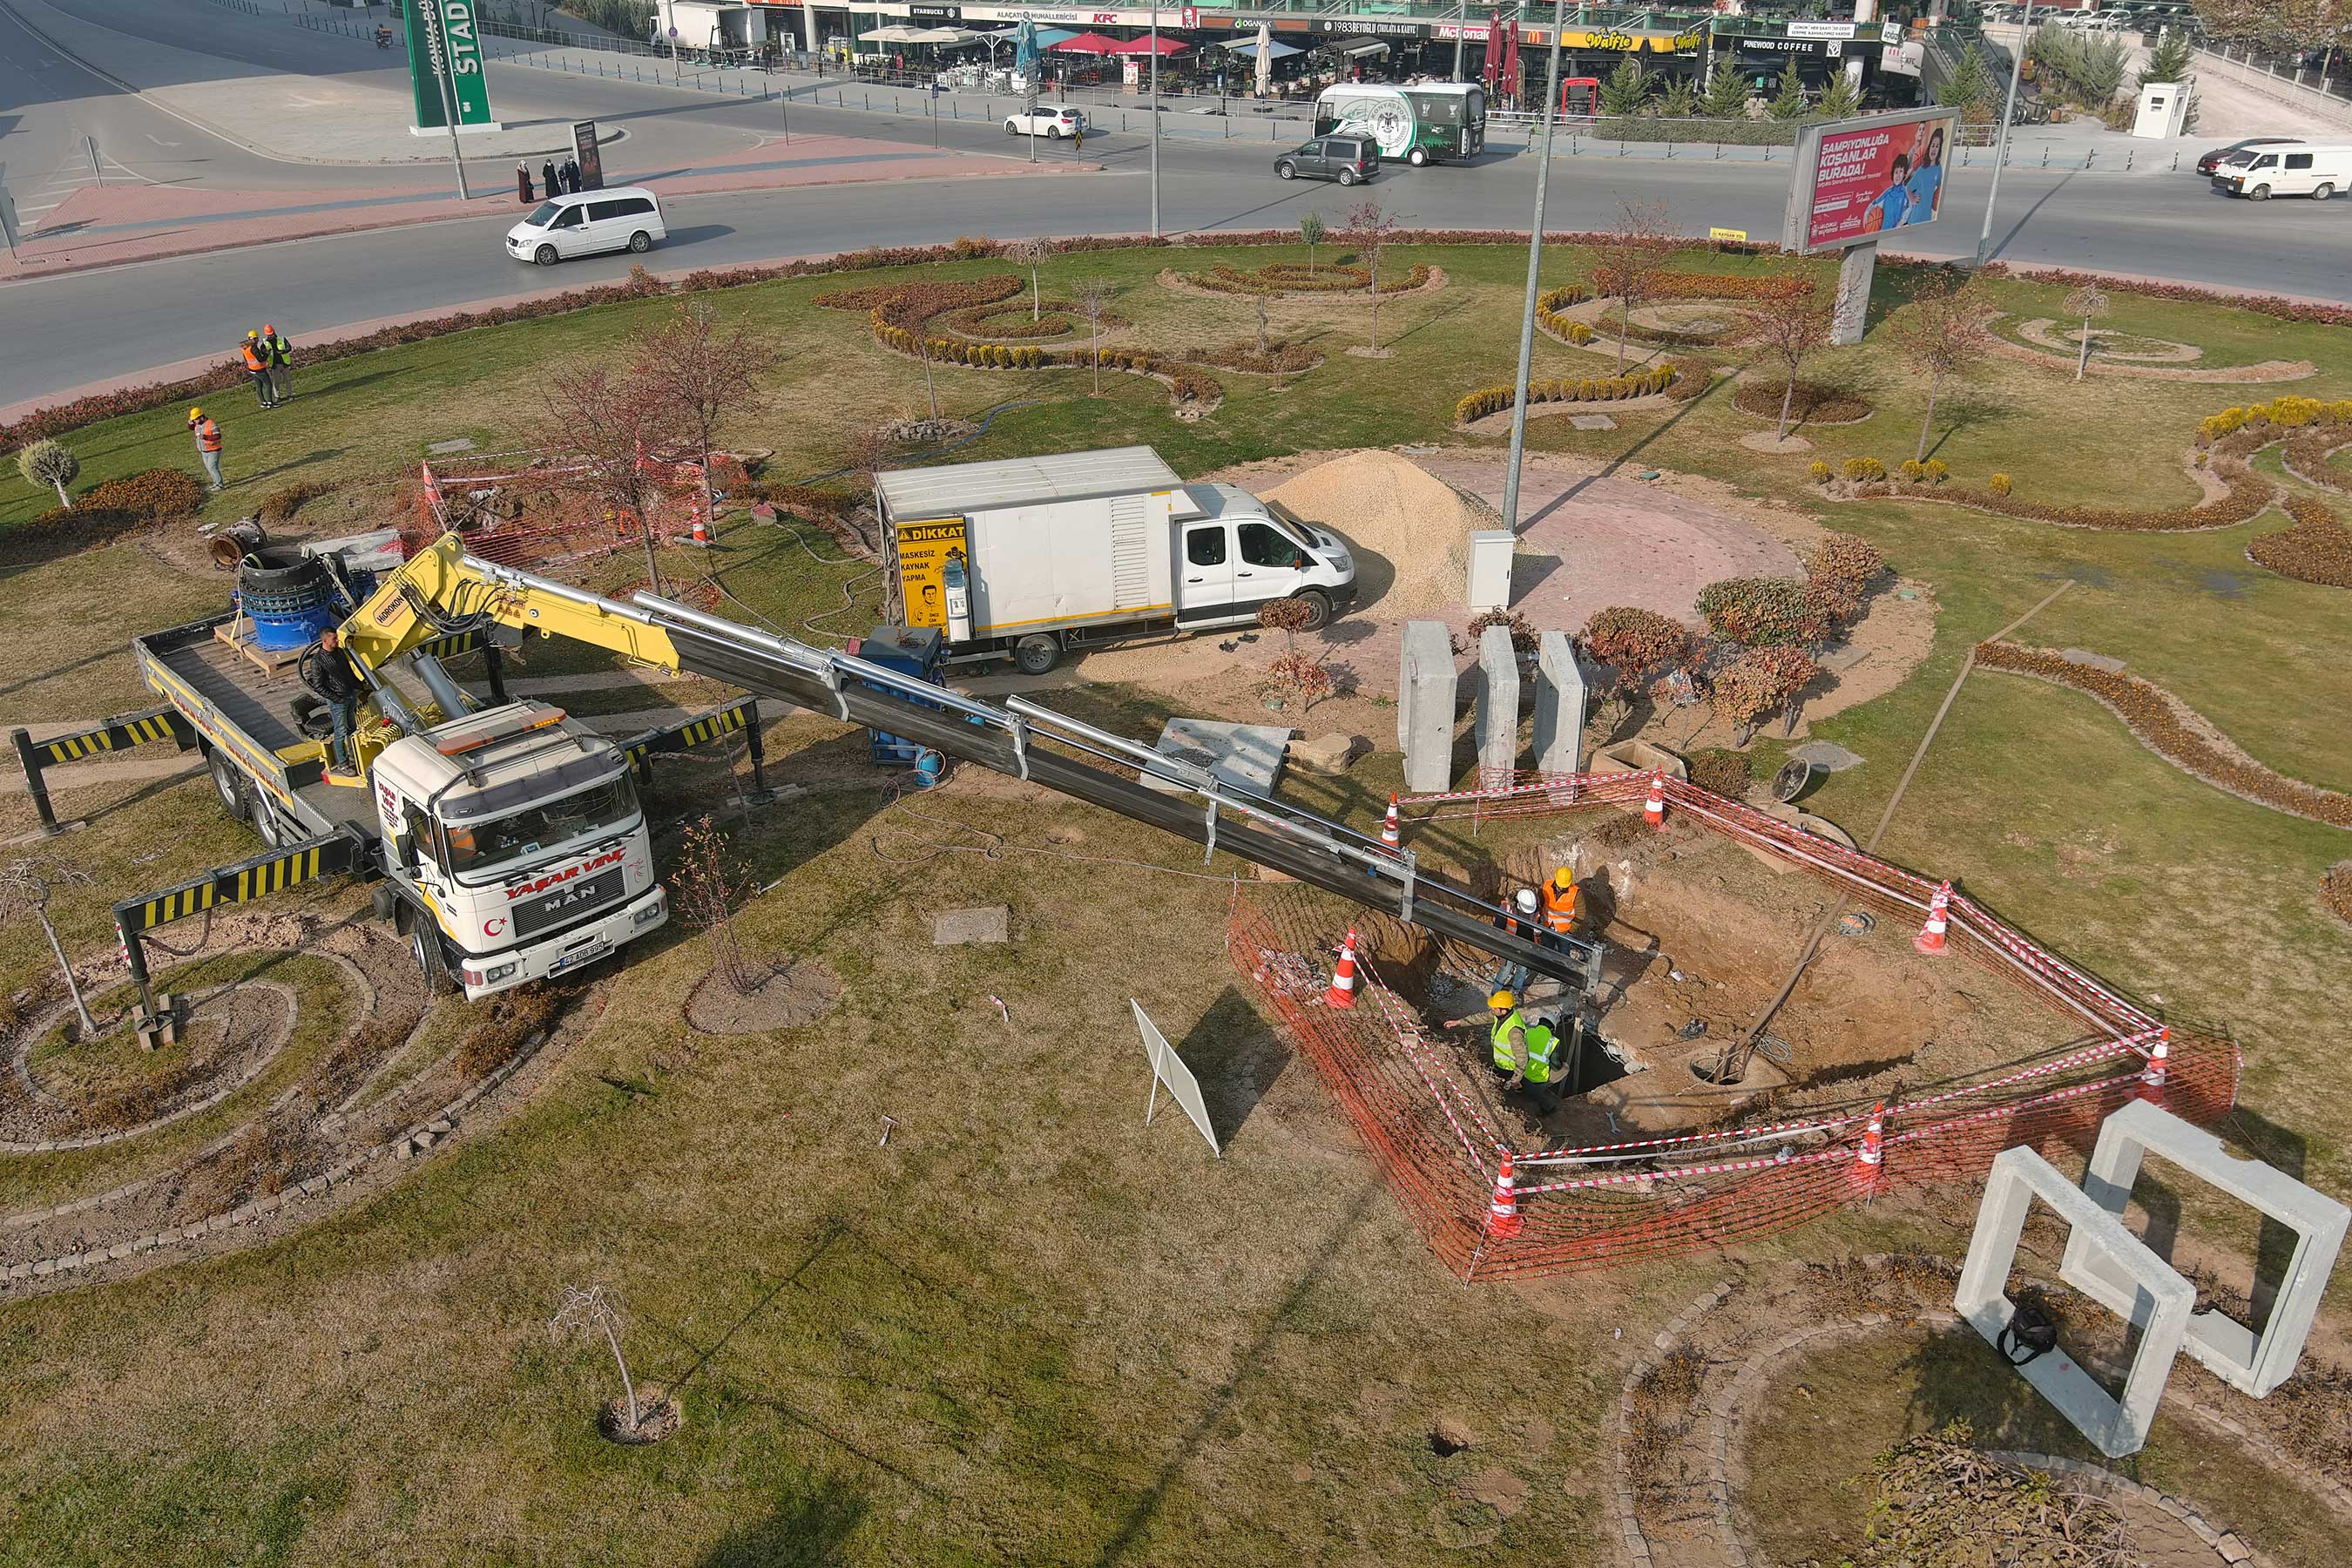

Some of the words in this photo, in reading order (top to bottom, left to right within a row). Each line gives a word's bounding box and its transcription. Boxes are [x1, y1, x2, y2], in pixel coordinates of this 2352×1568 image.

[1092, 13, 1118, 24] KFC
[1334, 21, 1353, 32] 1983
[1585, 30, 1632, 50] Waffle
[1743, 40, 1775, 50] PINEWOOD
[1777, 42, 1814, 51] COFFEE
[1370, 102, 1407, 120] KONYASPOR
[1819, 147, 1877, 168] KOŞANLAR
[1817, 163, 1866, 182] BURADA!
[912, 526, 964, 541] DİKKAT
[899, 549, 936, 559] MASKESİZ
[901, 562, 929, 571] KAYNAK
[902, 573, 926, 583] YAPMA
[504, 866, 579, 901] YAŞAR
[544, 885, 596, 912] MAN
